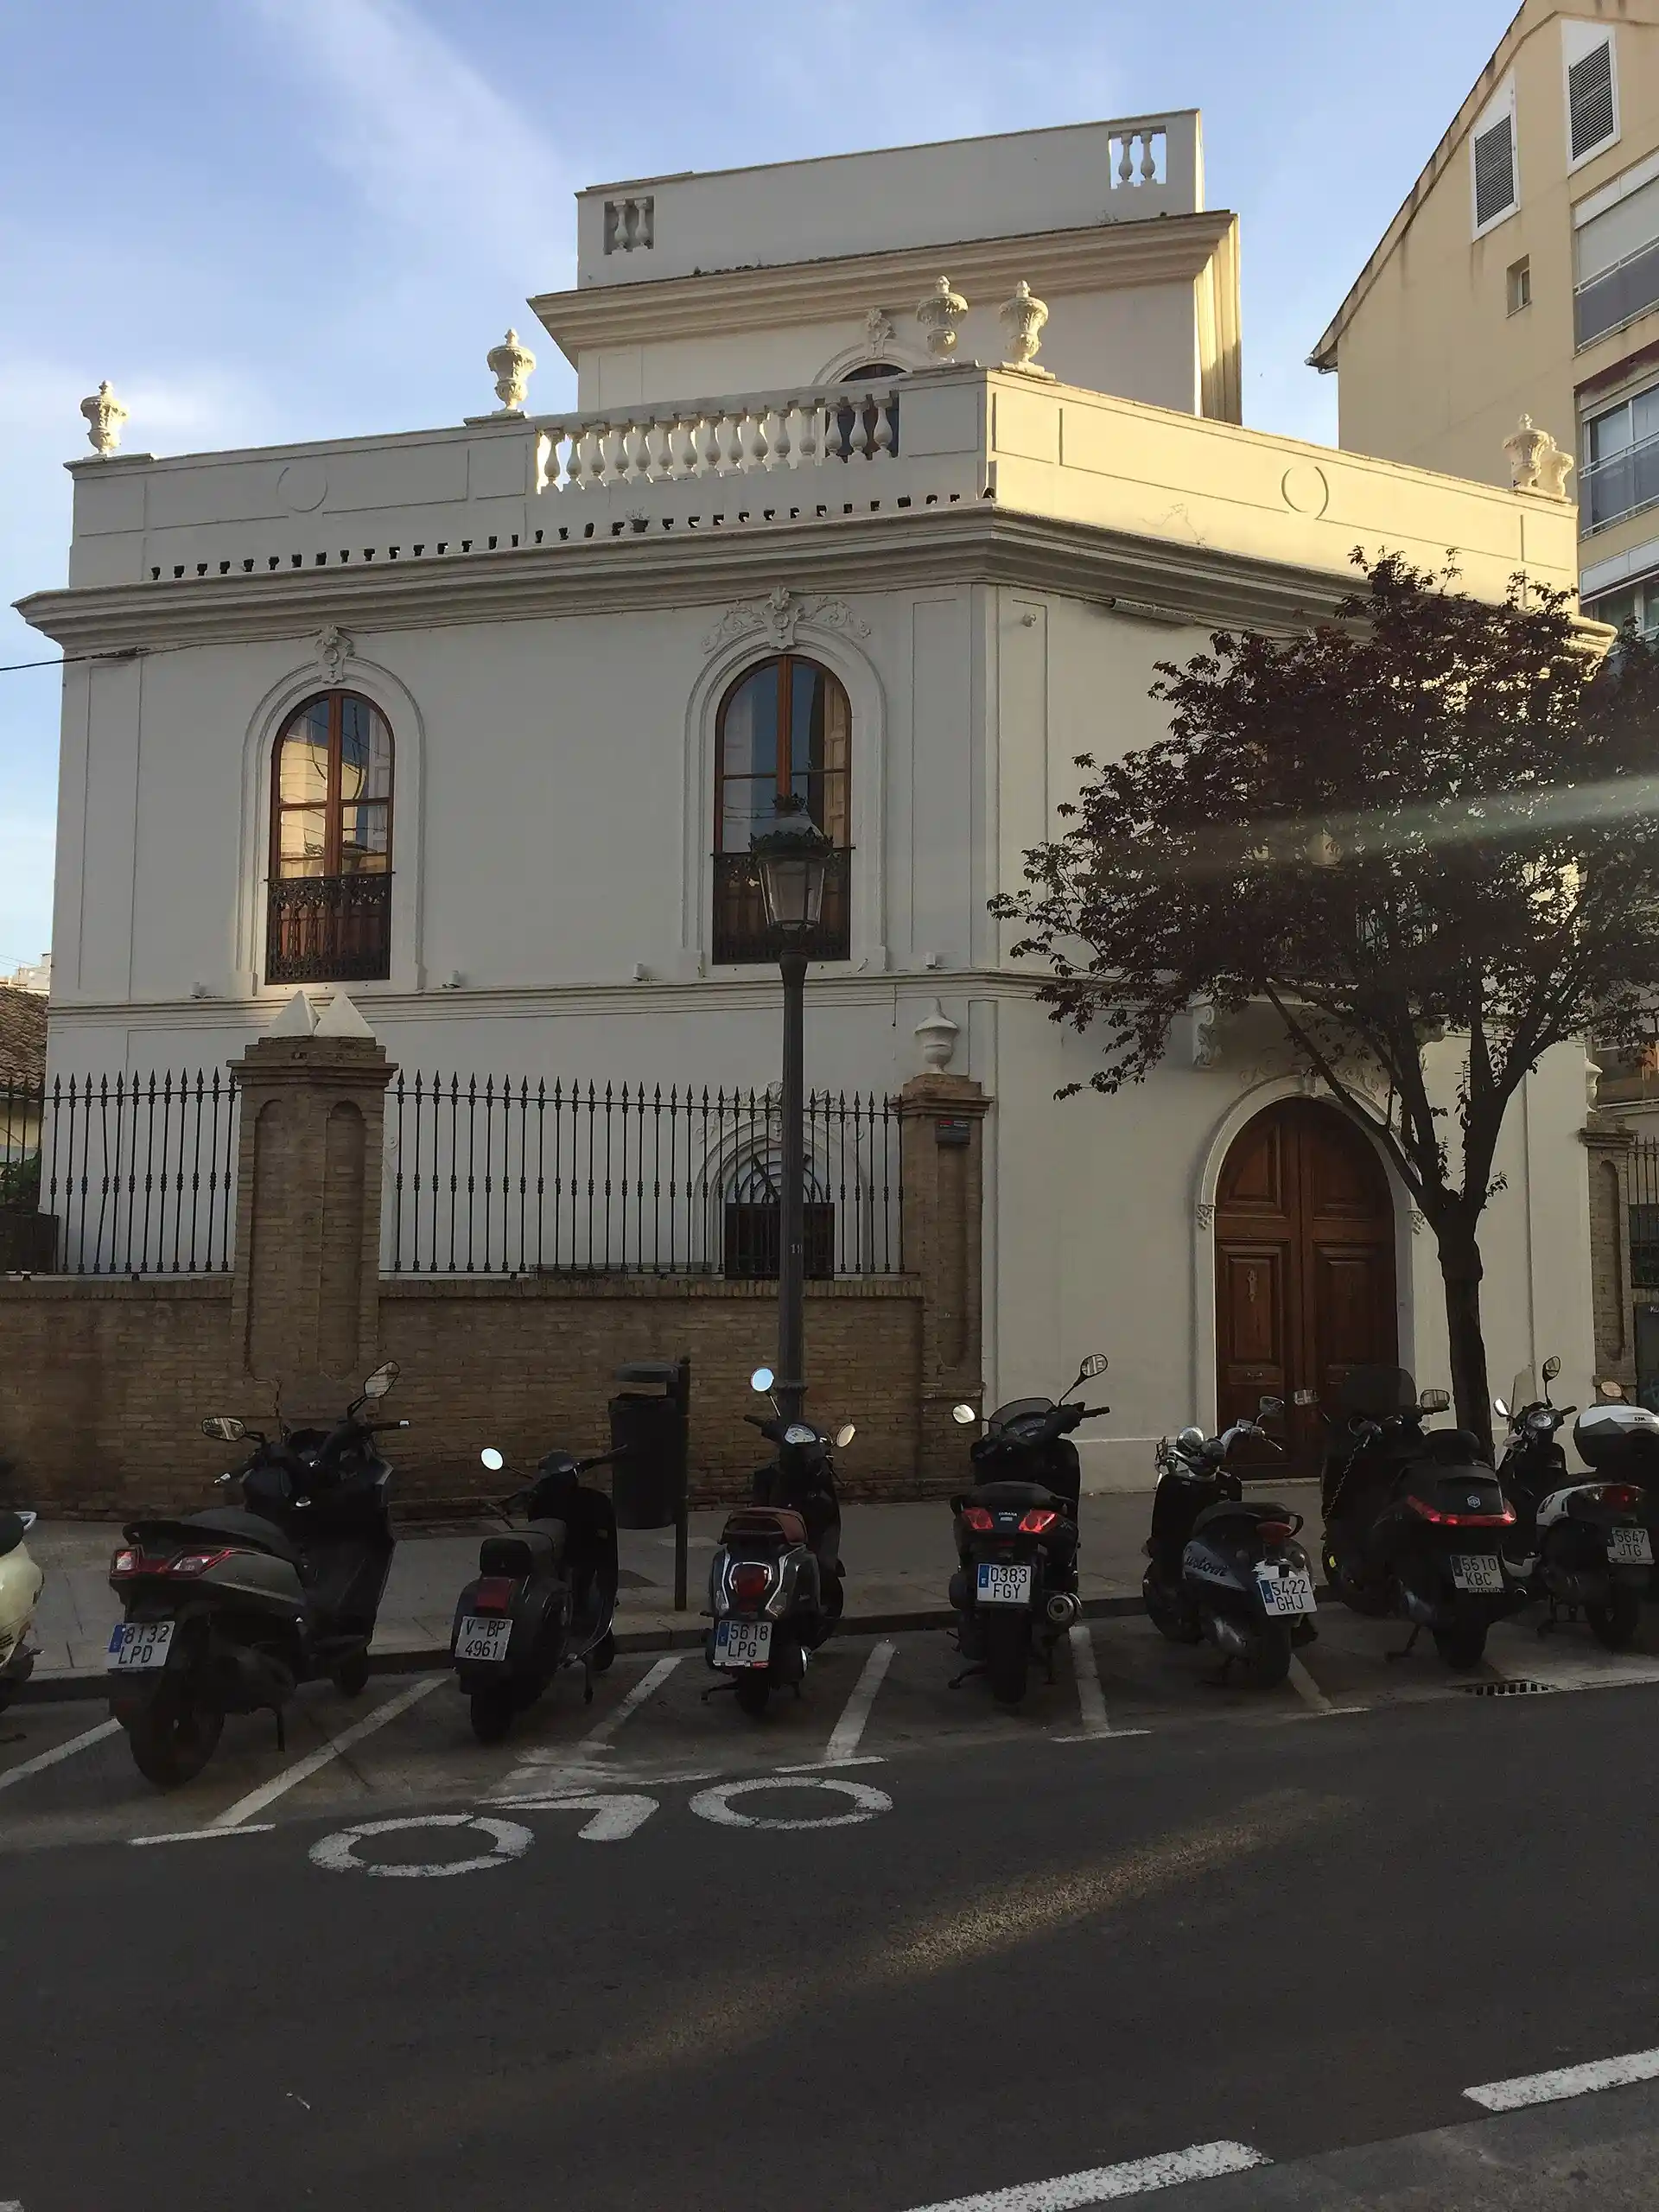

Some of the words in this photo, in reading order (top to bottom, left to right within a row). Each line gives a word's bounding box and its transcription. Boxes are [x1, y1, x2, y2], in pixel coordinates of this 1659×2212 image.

[1462, 1557, 1497, 1572] 5510
[990, 1567, 1027, 1584] 0383
[1465, 1572, 1492, 1586] KBC
[993, 1583, 1021, 1599] FGY
[1270, 1579, 1308, 1597] 5422
[1276, 1595, 1304, 1611] GHJ
[124, 1624, 170, 1644] 8132
[730, 1624, 769, 1641] 5618
[118, 1645, 153, 1664] LPD
[465, 1639, 499, 1658] 4961
[728, 1641, 757, 1657] LPG
